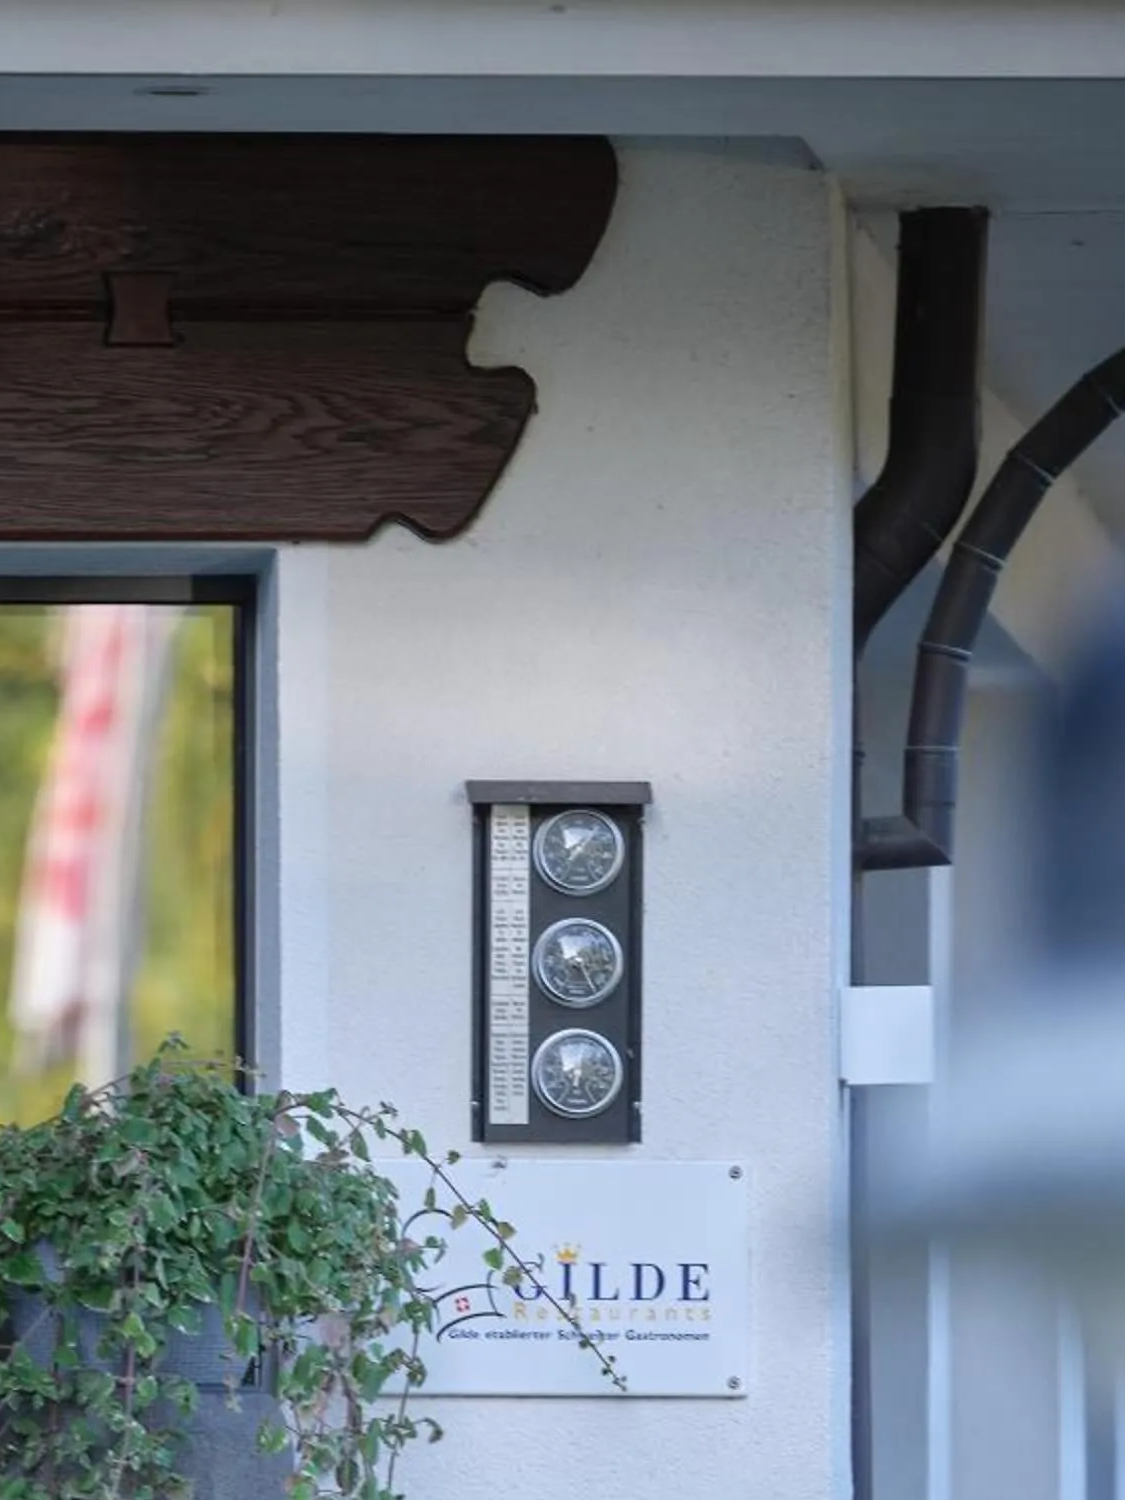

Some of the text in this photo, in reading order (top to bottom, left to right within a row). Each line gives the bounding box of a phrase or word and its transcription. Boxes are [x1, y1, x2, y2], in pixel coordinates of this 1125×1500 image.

[511, 1259, 711, 1301] GILDE
[513, 1302, 712, 1322] Restaurants
[448, 1328, 479, 1340] Gilde
[625, 1328, 711, 1341] Gastronomen
